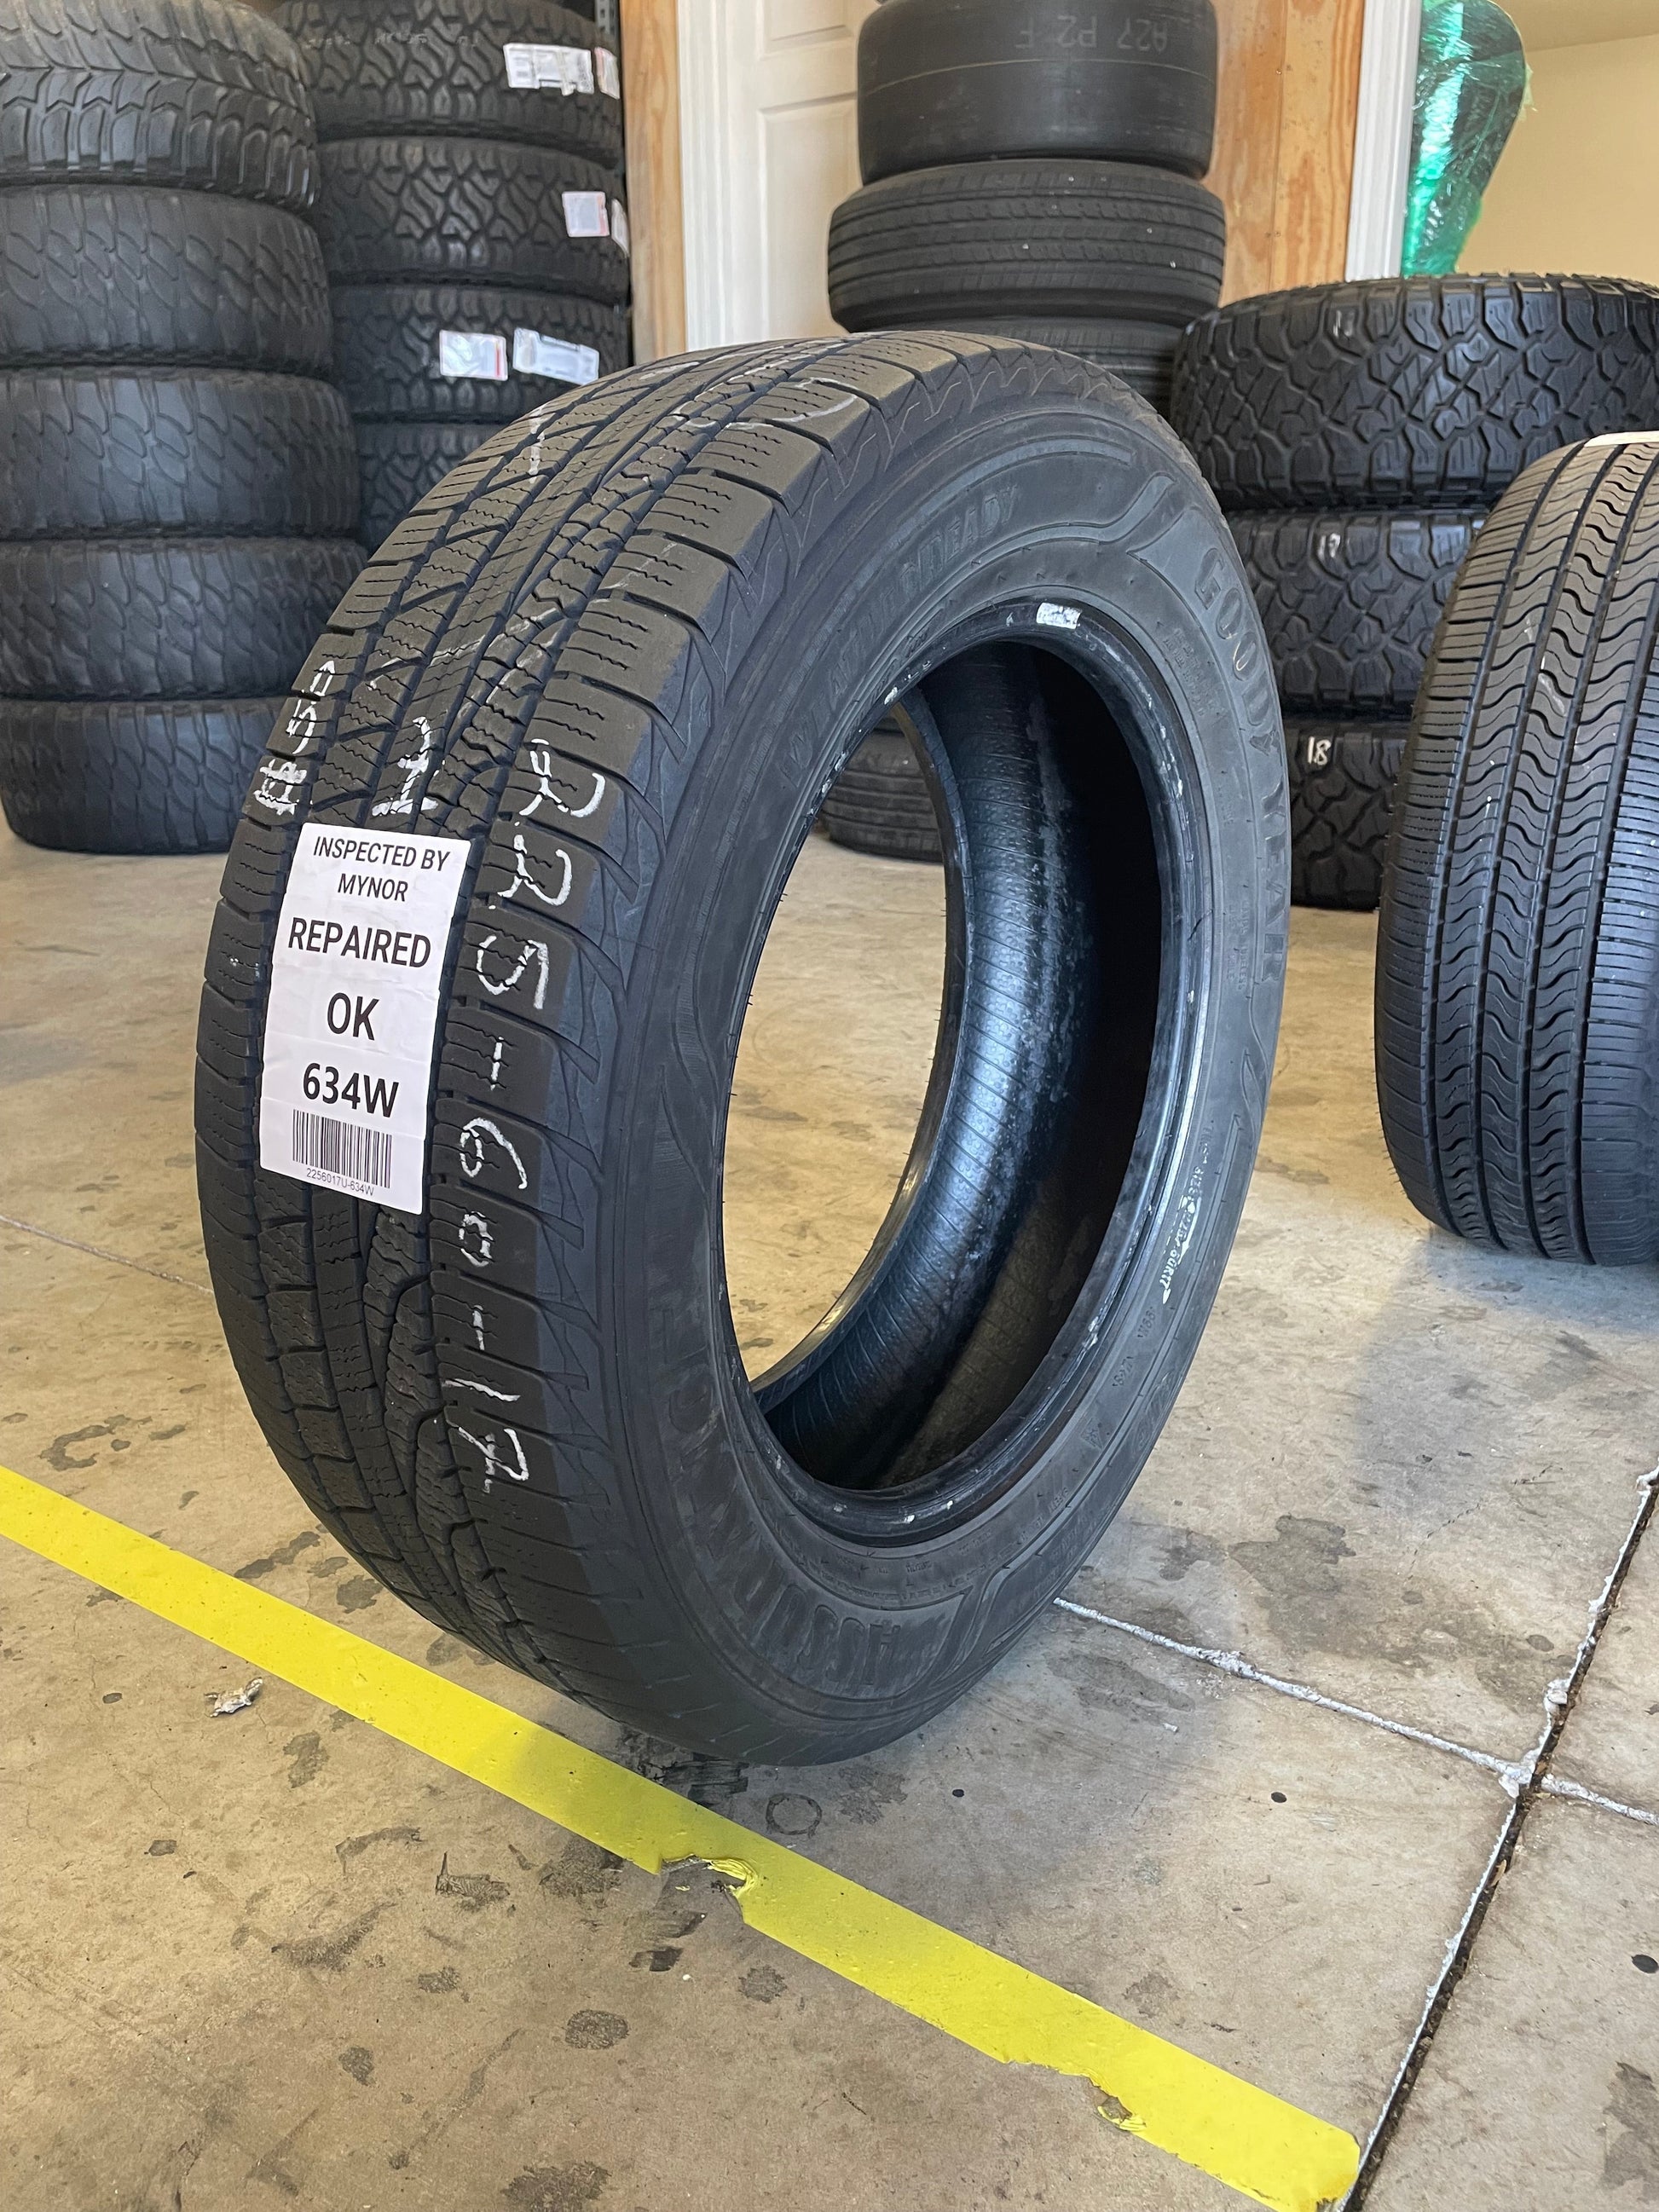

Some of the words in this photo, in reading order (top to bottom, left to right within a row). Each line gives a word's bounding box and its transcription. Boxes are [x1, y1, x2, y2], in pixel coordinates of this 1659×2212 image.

[1058, 15, 1097, 48] P2
[1307, 736, 1331, 765] 18
[314, 836, 416, 867] INSPECTED
[420, 848, 450, 871] BY
[338, 873, 408, 902] MYNOR
[288, 916, 431, 968] REPAIRED
[327, 992, 379, 1041] OK
[303, 1063, 399, 1118] 634W
[306, 1168, 374, 1197] 2256017U-634W
